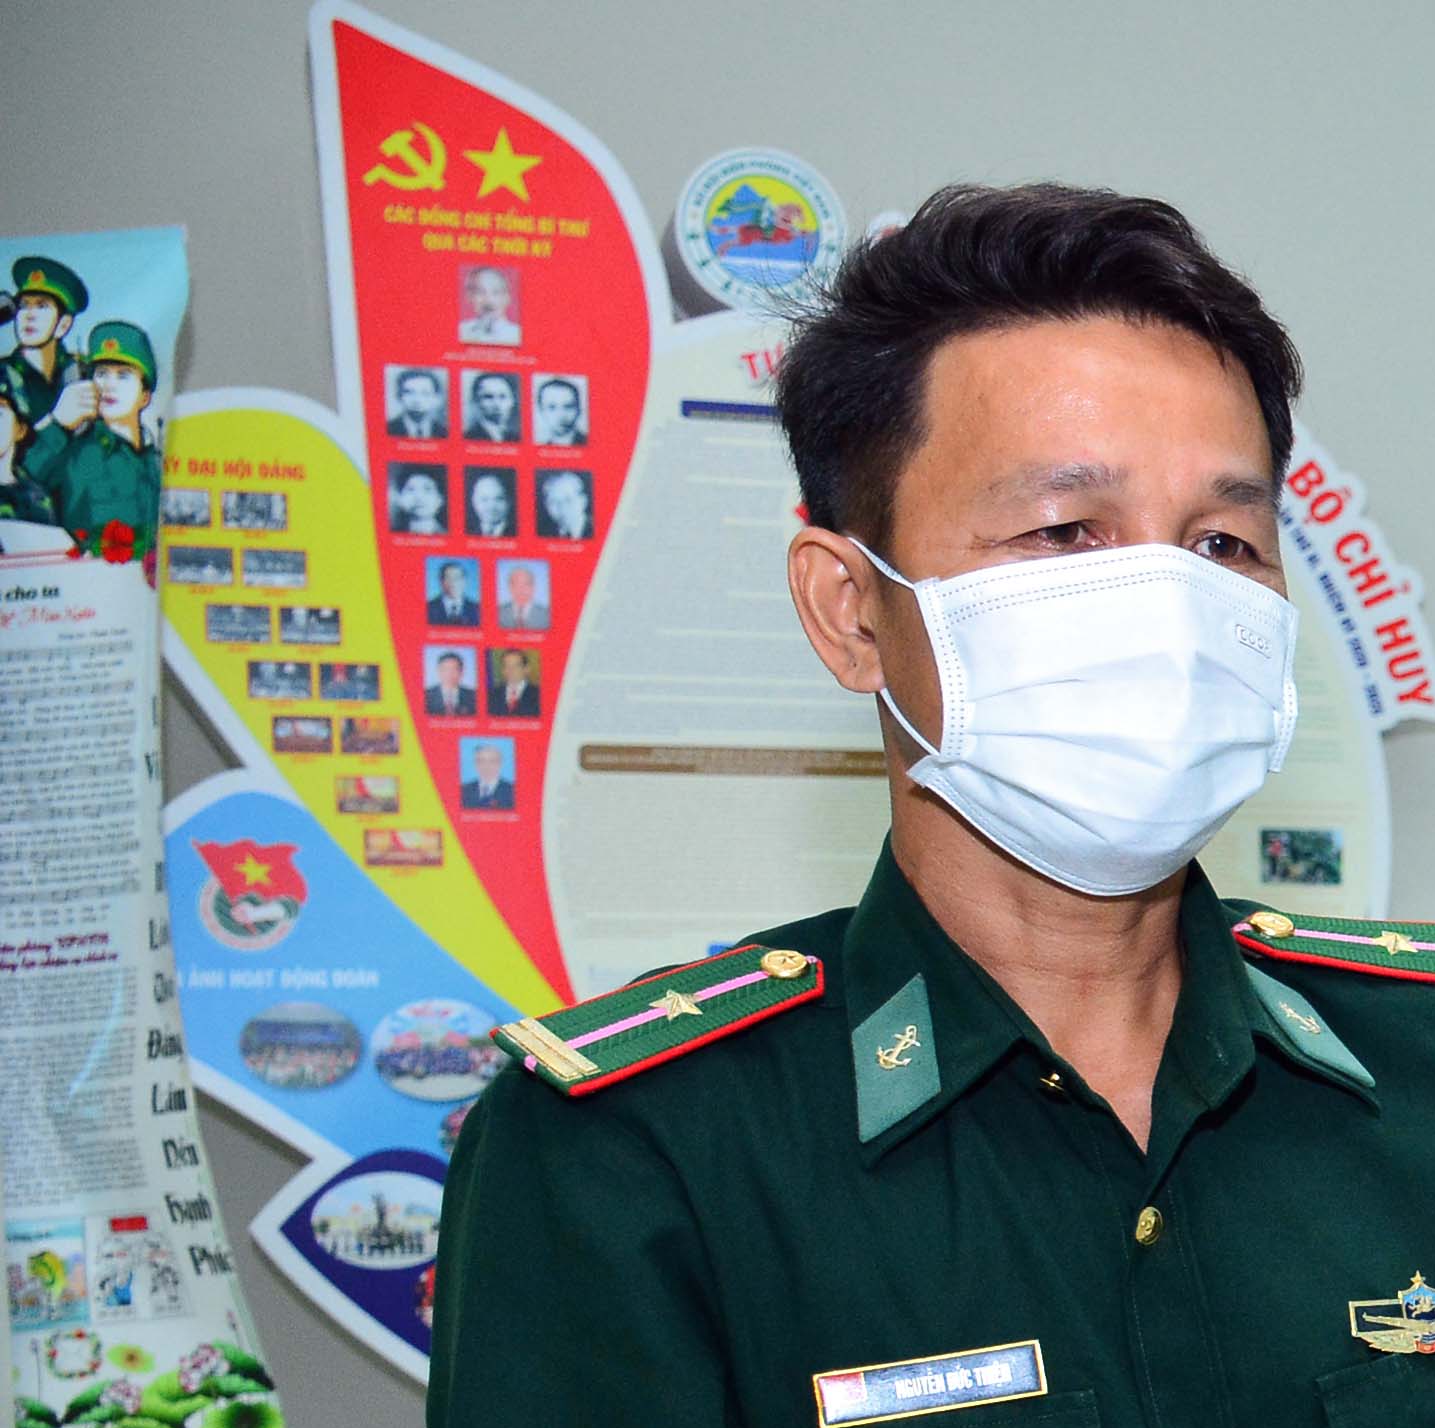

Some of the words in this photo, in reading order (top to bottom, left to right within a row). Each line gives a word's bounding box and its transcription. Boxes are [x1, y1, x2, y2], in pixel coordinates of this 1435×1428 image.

[1286, 460, 1353, 528] BỘ
[1334, 528, 1413, 609] CHỈ
[1374, 617, 1435, 707] HUY
